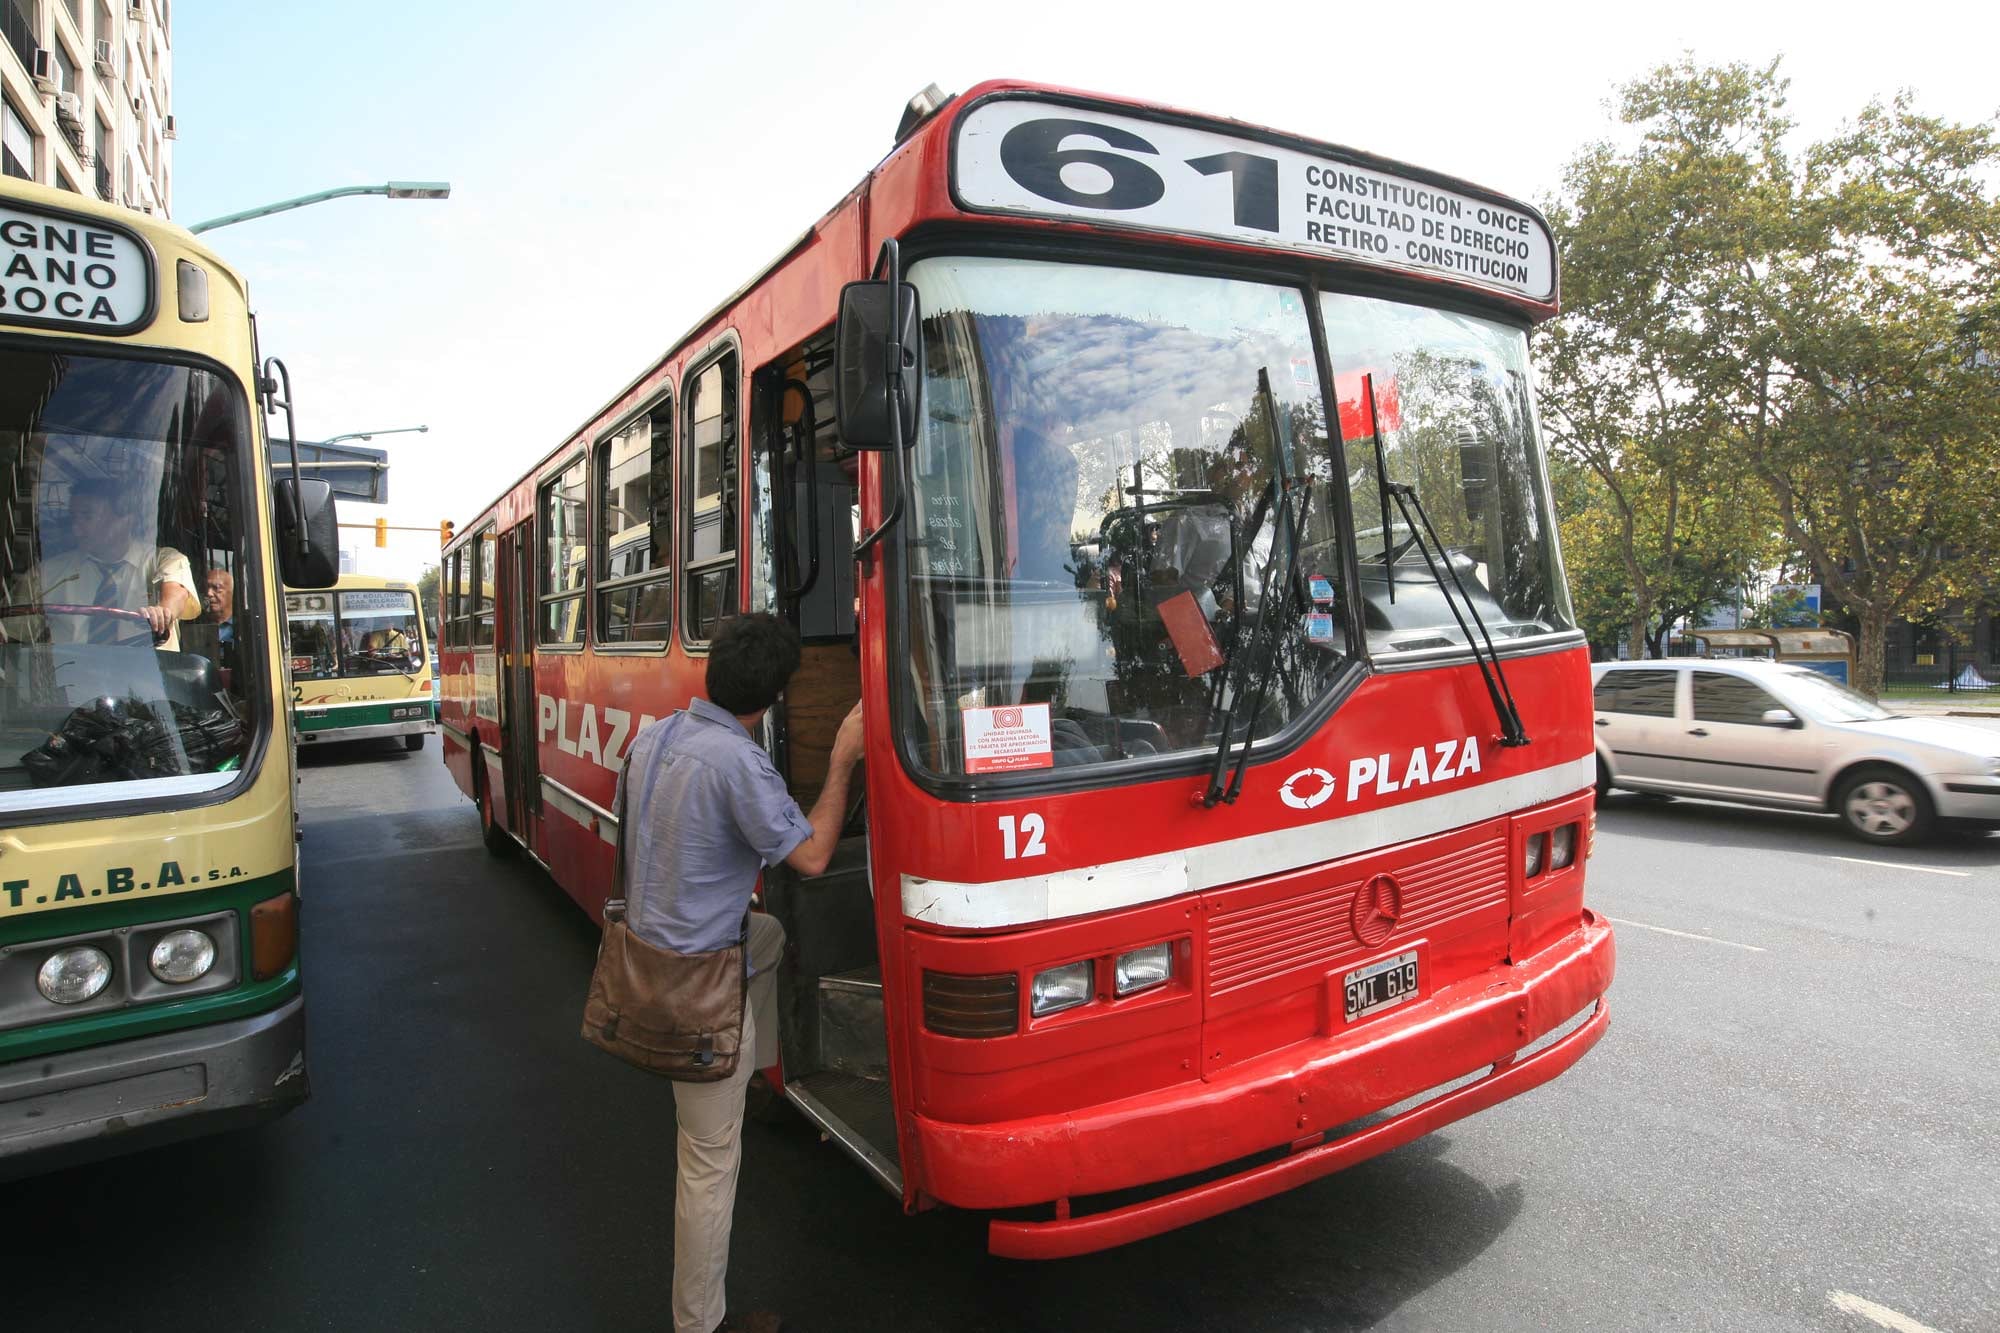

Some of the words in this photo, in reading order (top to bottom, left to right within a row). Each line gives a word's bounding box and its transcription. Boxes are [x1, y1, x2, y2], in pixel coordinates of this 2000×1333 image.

[1000, 118, 1280, 233] 61
[1306, 165, 1462, 219] CONSTITUCION
[1476, 208, 1530, 235] ONCE
[1306, 193, 1416, 233] FACULTAD
[1421, 218, 1445, 241] DE
[1451, 225, 1529, 260] DERECHO
[1306, 221, 1388, 254] RETIRO
[1406, 241, 1528, 284] CONSTITUCION
[0, 285, 118, 322] OCA
[1346, 736, 1481, 802] PLAZA
[998, 812, 1047, 860] 12
[1346, 977, 1378, 1013] SMI
[1386, 963, 1416, 998] 619
